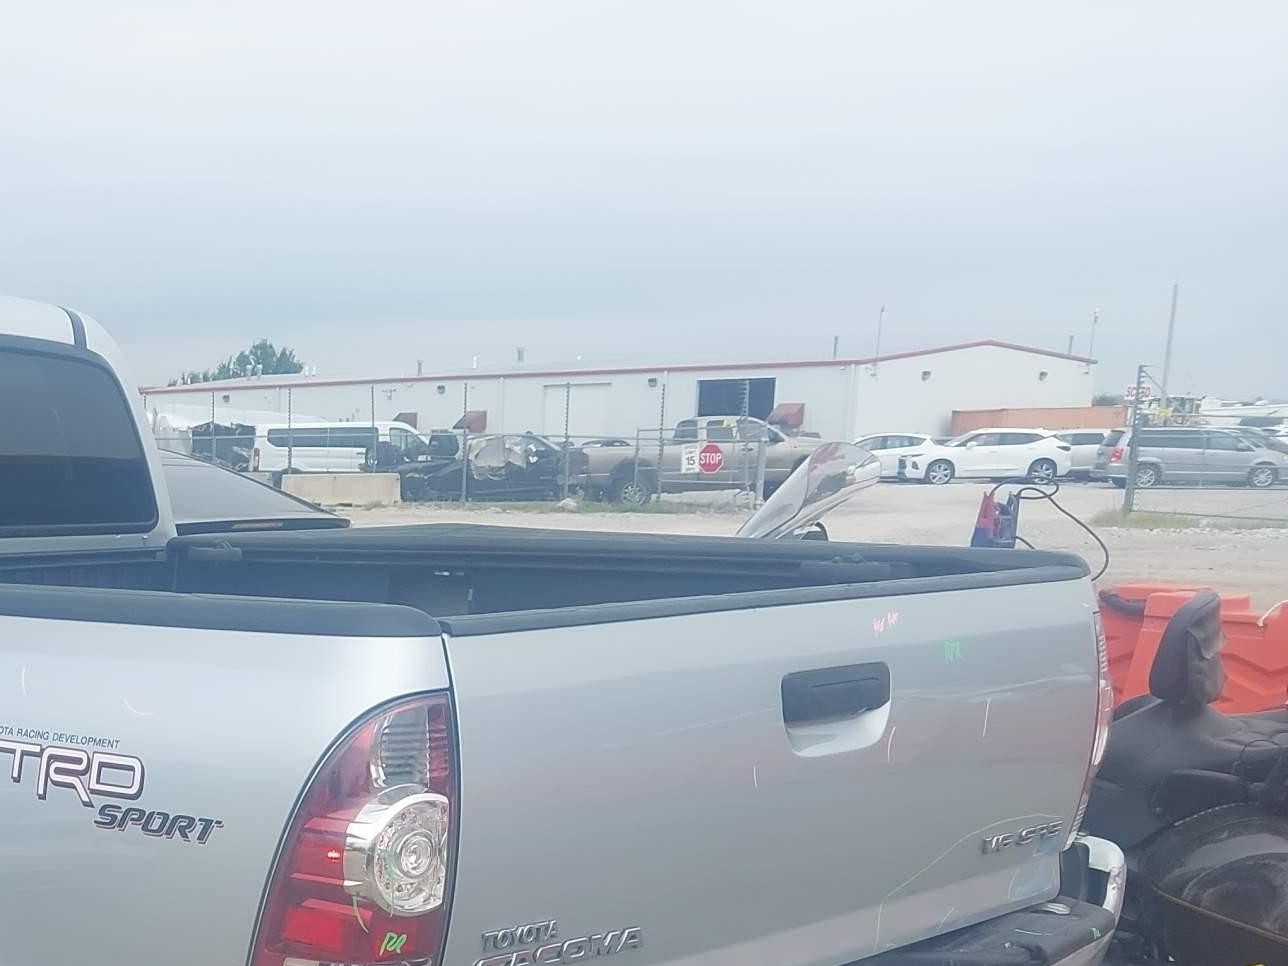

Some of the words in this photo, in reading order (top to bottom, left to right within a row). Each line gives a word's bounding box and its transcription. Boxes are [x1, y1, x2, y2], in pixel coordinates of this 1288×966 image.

[686, 455, 696, 466] 15
[699, 452, 722, 465] STOP
[16, 728, 50, 741] RACING
[52, 732, 121, 749] DEVELOPMENT
[93, 803, 225, 845] SPORT
[482, 919, 558, 951] TOYOTA
